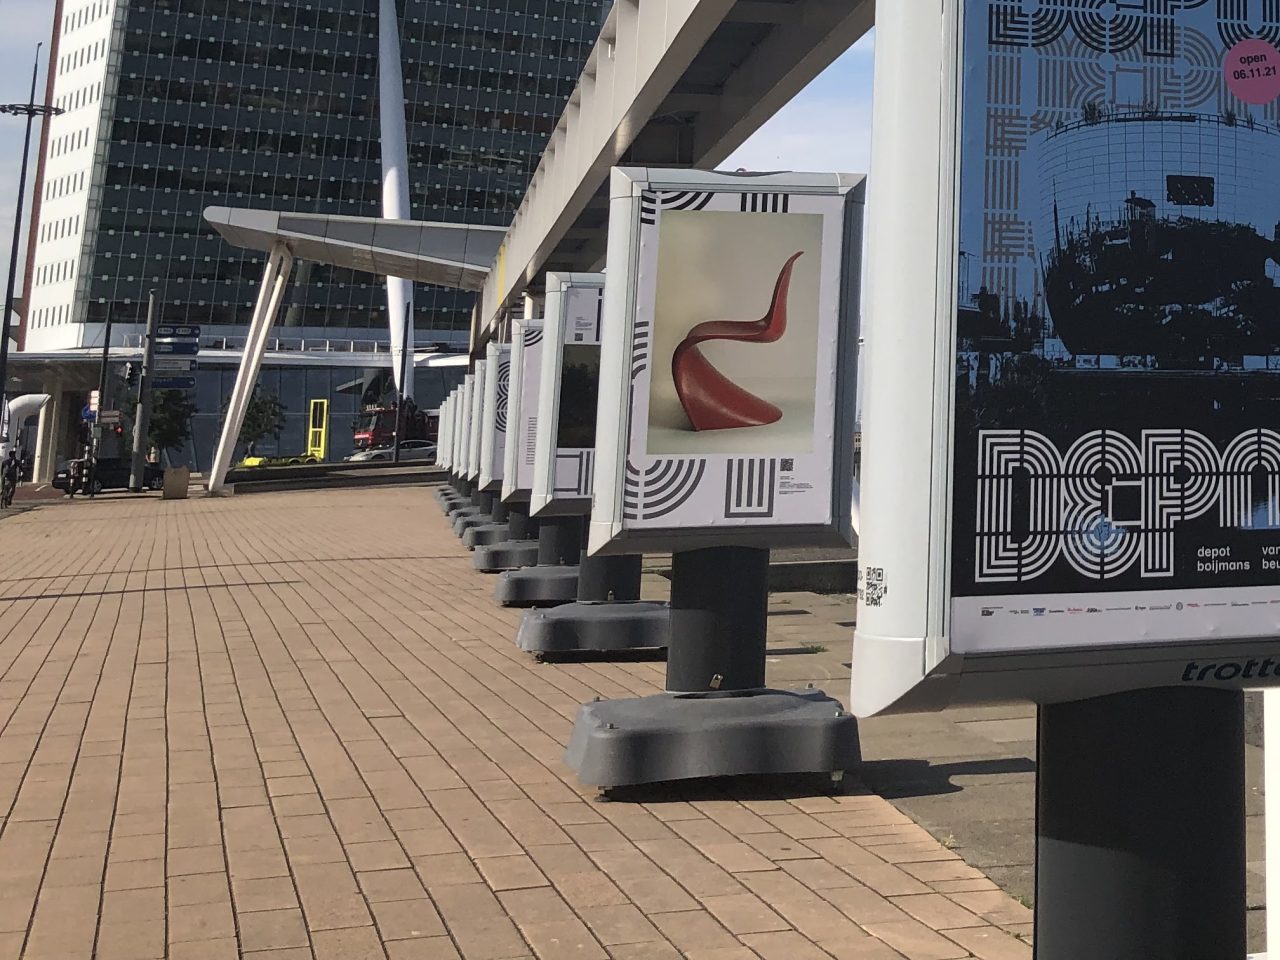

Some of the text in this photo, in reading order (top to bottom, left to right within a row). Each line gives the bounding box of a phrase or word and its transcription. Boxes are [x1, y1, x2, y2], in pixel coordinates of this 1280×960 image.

[1239, 54, 1267, 66] open
[1233, 66, 1277, 80] 06.11.21
[1197, 546, 1231, 559] depot
[1197, 560, 1250, 574] boijmans
